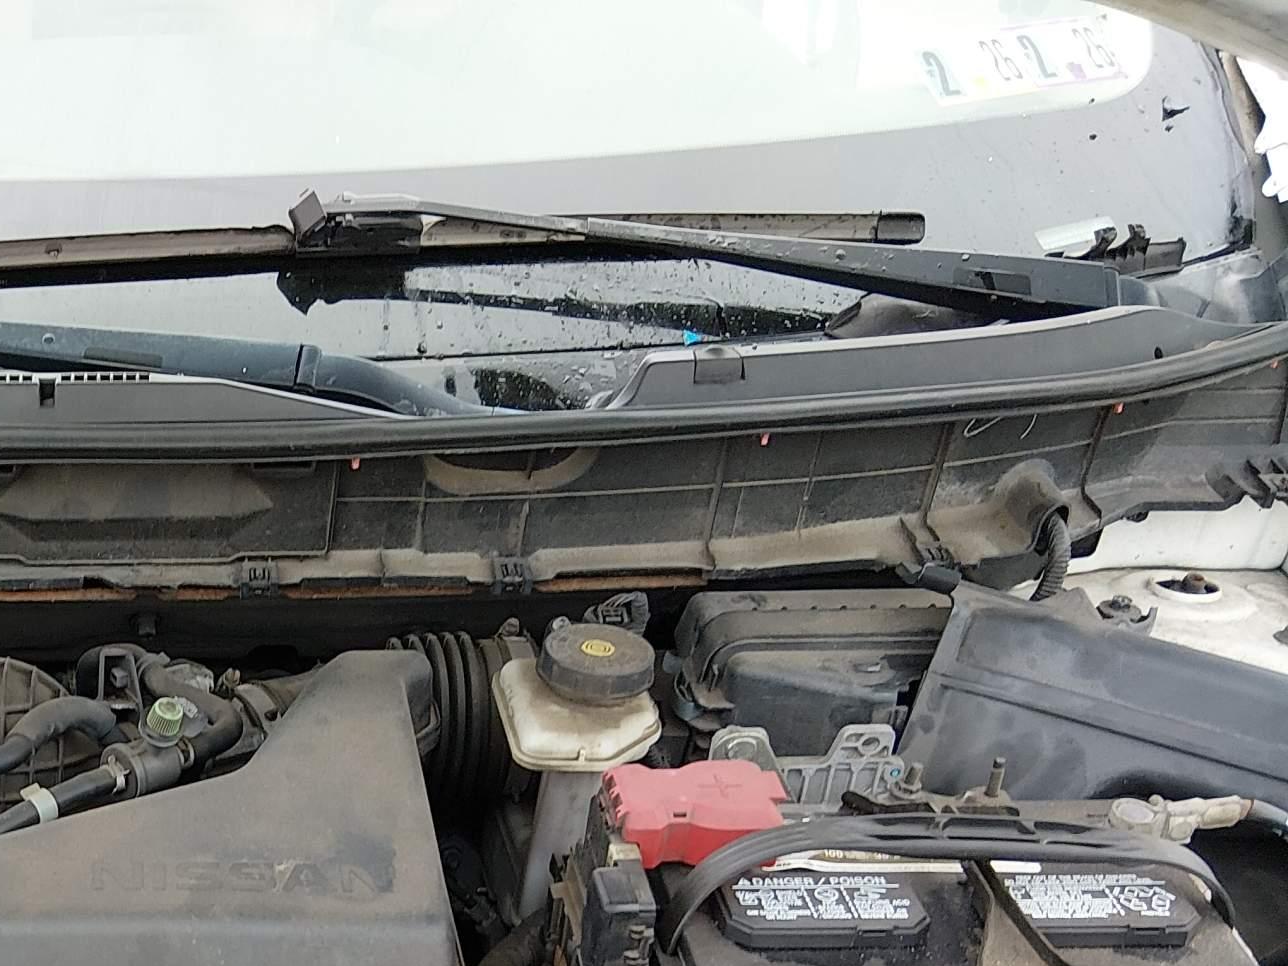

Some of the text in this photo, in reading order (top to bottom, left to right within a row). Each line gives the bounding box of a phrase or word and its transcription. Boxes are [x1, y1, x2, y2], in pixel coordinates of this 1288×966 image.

[921, 50, 962, 97] 2
[1016, 34, 1058, 79] 2
[90, 857, 397, 895] NISSAN
[751, 876, 813, 887] DANGER
[829, 875, 887, 886] POISON
